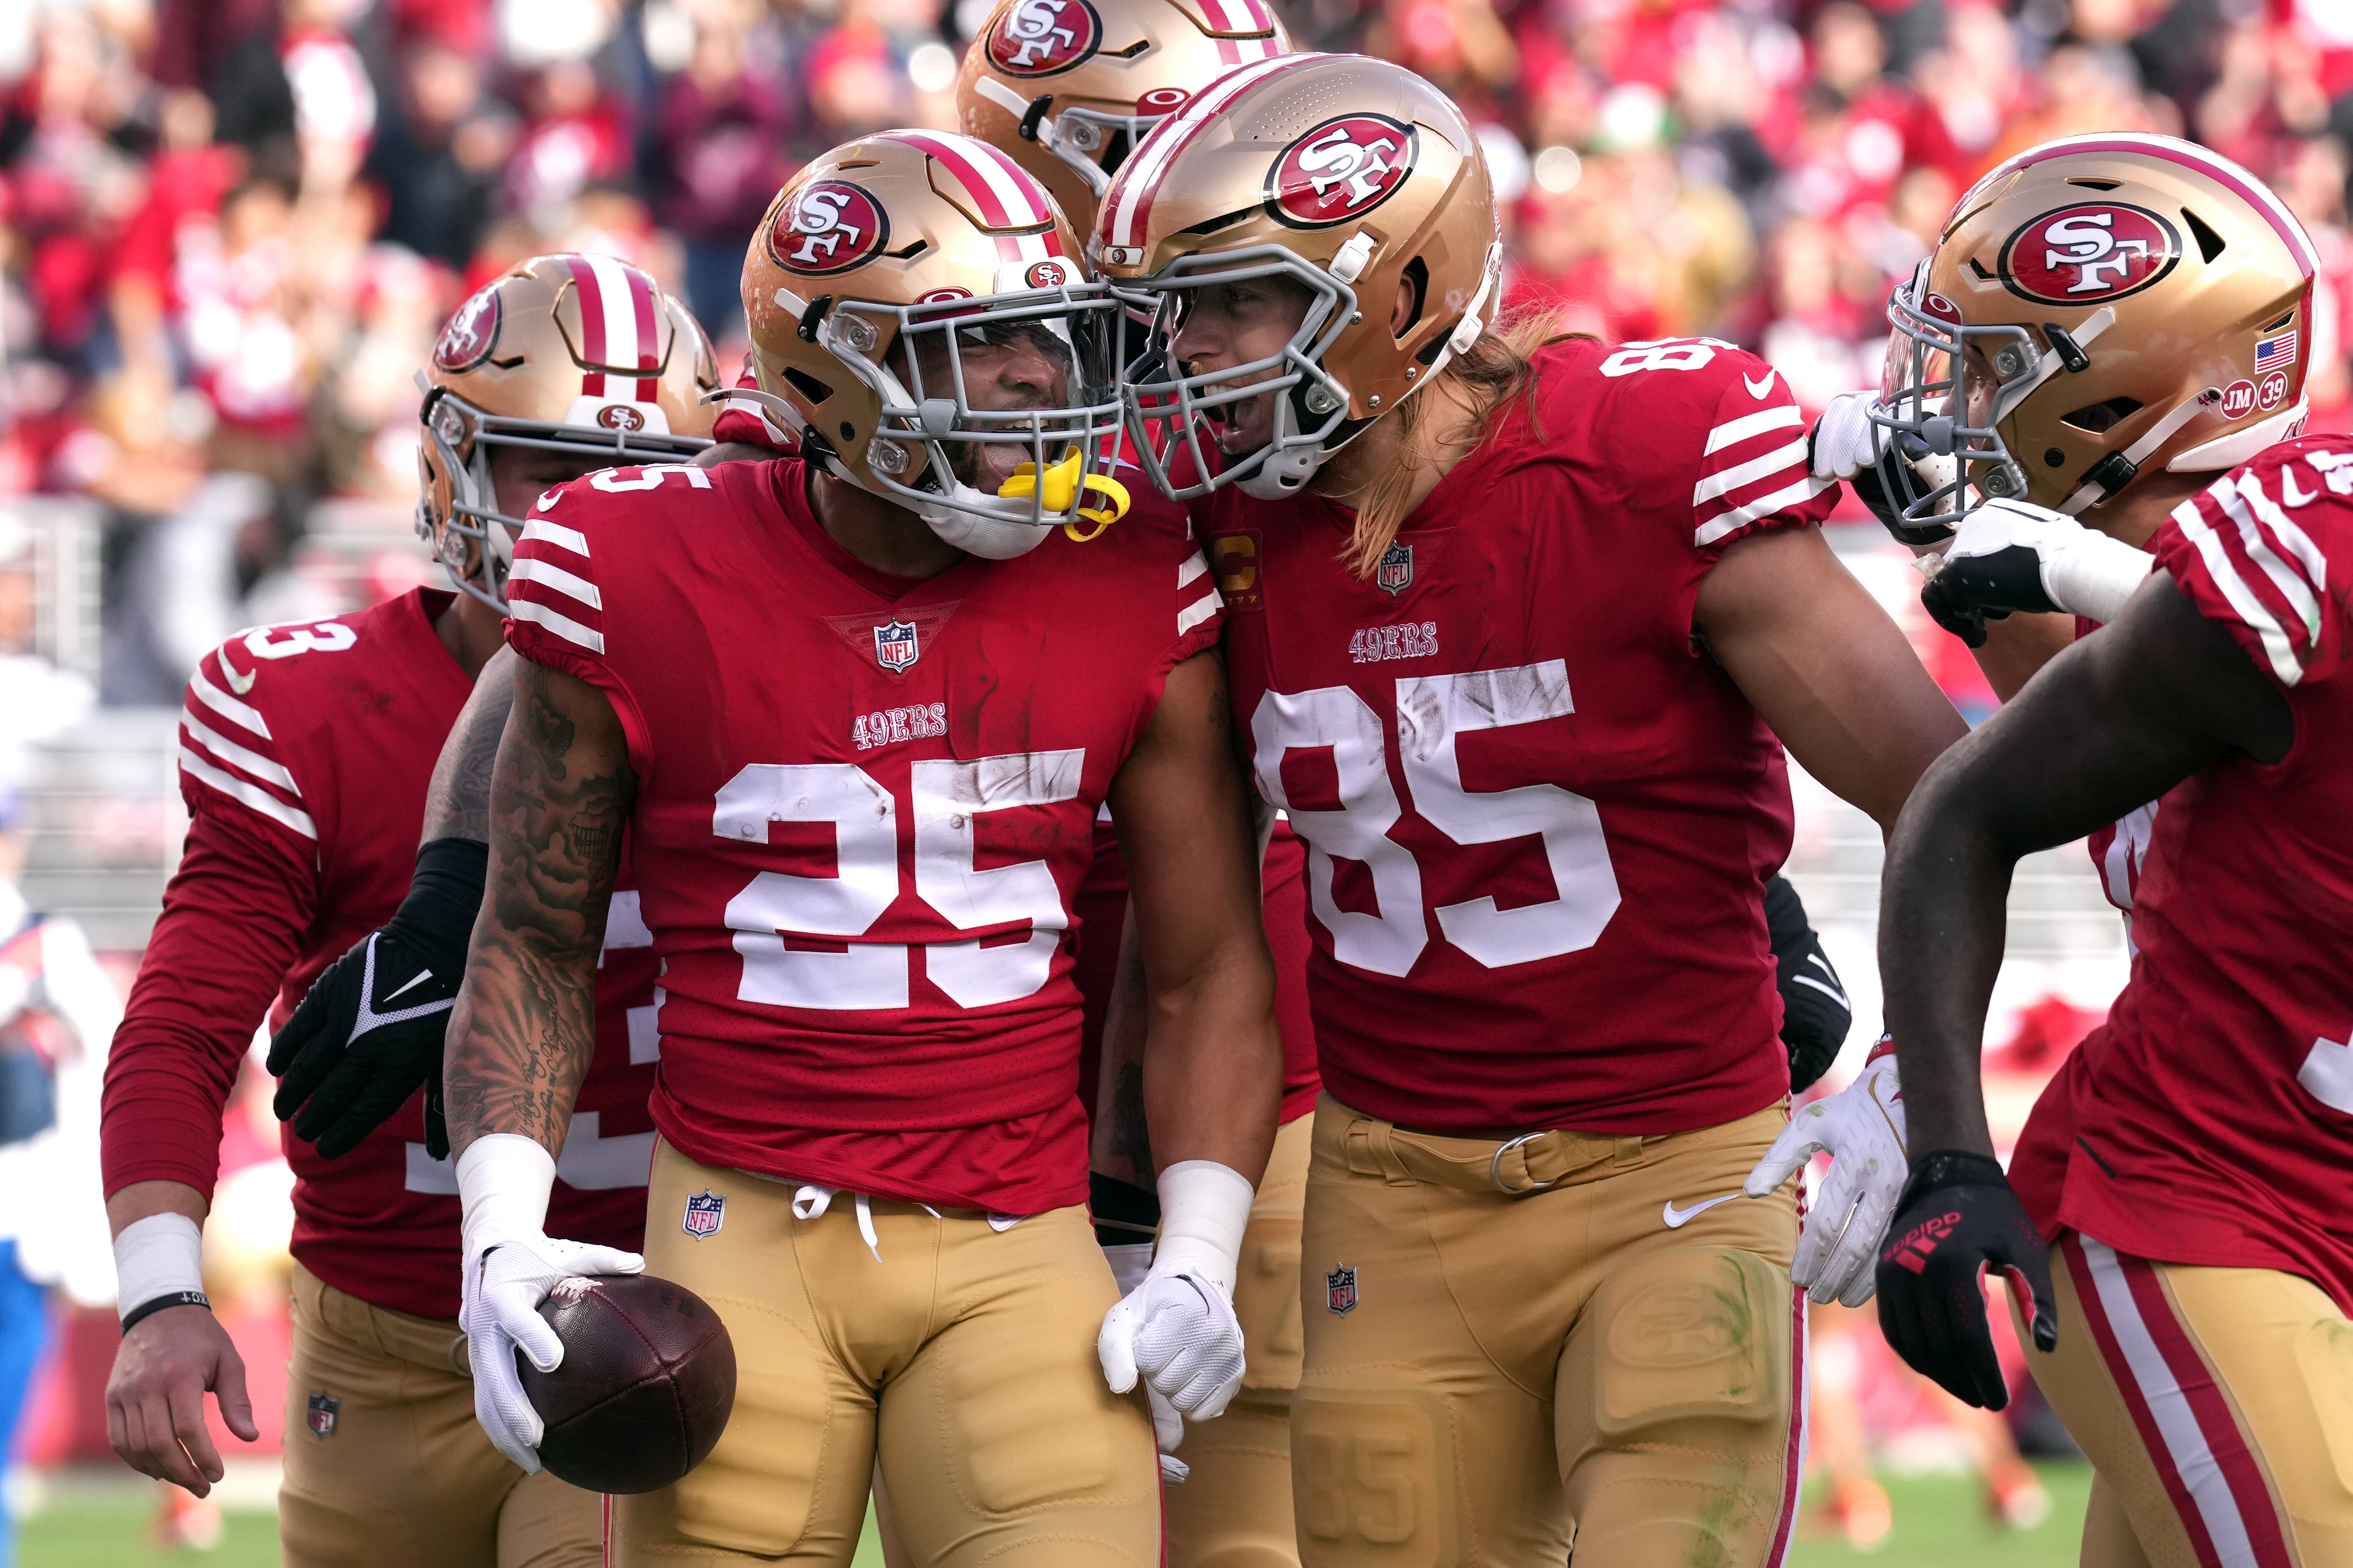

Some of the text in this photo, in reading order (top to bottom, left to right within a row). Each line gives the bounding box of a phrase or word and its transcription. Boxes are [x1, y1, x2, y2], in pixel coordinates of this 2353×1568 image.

[1008, 0, 1074, 66] SF
[1298, 127, 1399, 208] SF
[791, 191, 861, 263] SF
[2045, 213, 2149, 294] SF
[2224, 388, 2251, 410] JM
[2263, 378, 2284, 404] 39
[610, 407, 636, 430] SF
[1383, 565, 1405, 584] NFL
[883, 641, 913, 663] NFL
[1348, 621, 1438, 662] 49ERS
[851, 702, 948, 750] 49ERS
[1251, 658, 1621, 977] 85
[713, 748, 1086, 1010] 25
[689, 1211, 715, 1230] NFL
[1884, 1212, 1961, 1262] adidas
[1331, 1287, 1352, 1306] NFL
